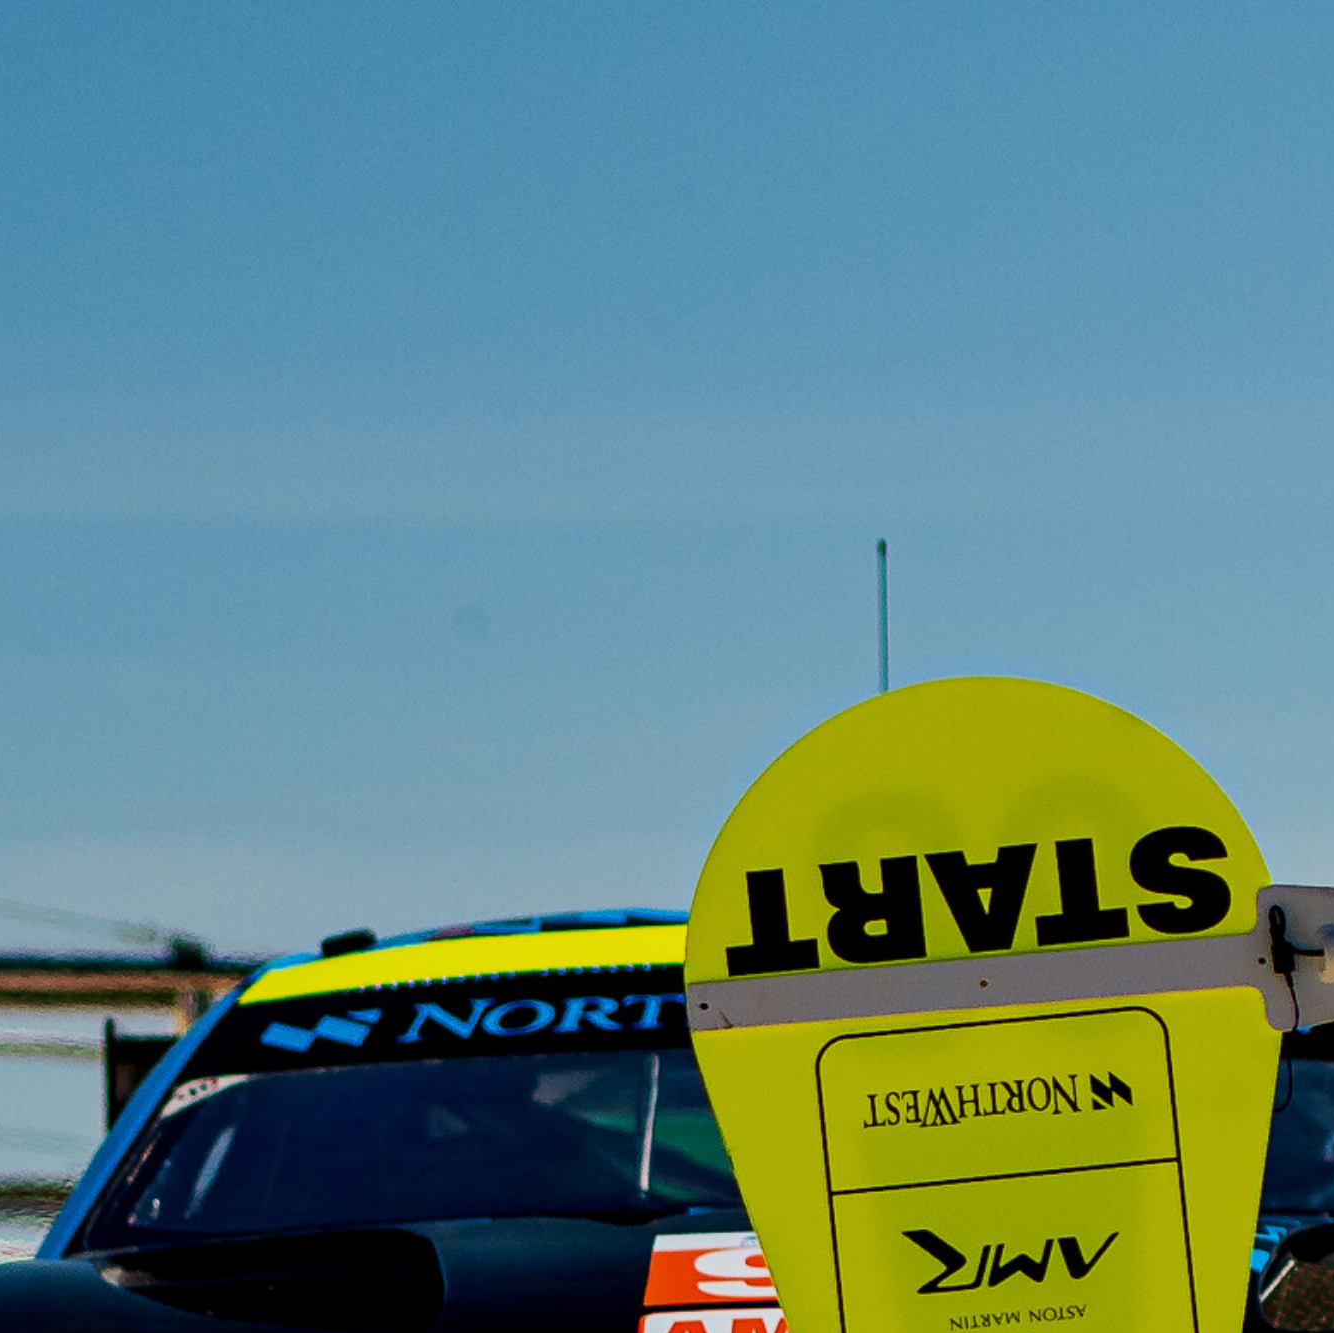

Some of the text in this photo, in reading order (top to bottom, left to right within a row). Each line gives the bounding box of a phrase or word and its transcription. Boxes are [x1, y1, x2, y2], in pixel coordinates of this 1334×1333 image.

[726, 825, 1232, 977] START
[396, 992, 688, 1044] NORT
[863, 1074, 1083, 1129] NORTHWEST
[901, 1228, 1120, 1295] AMR
[948, 1304, 1087, 1332] ASTON MARTIN
